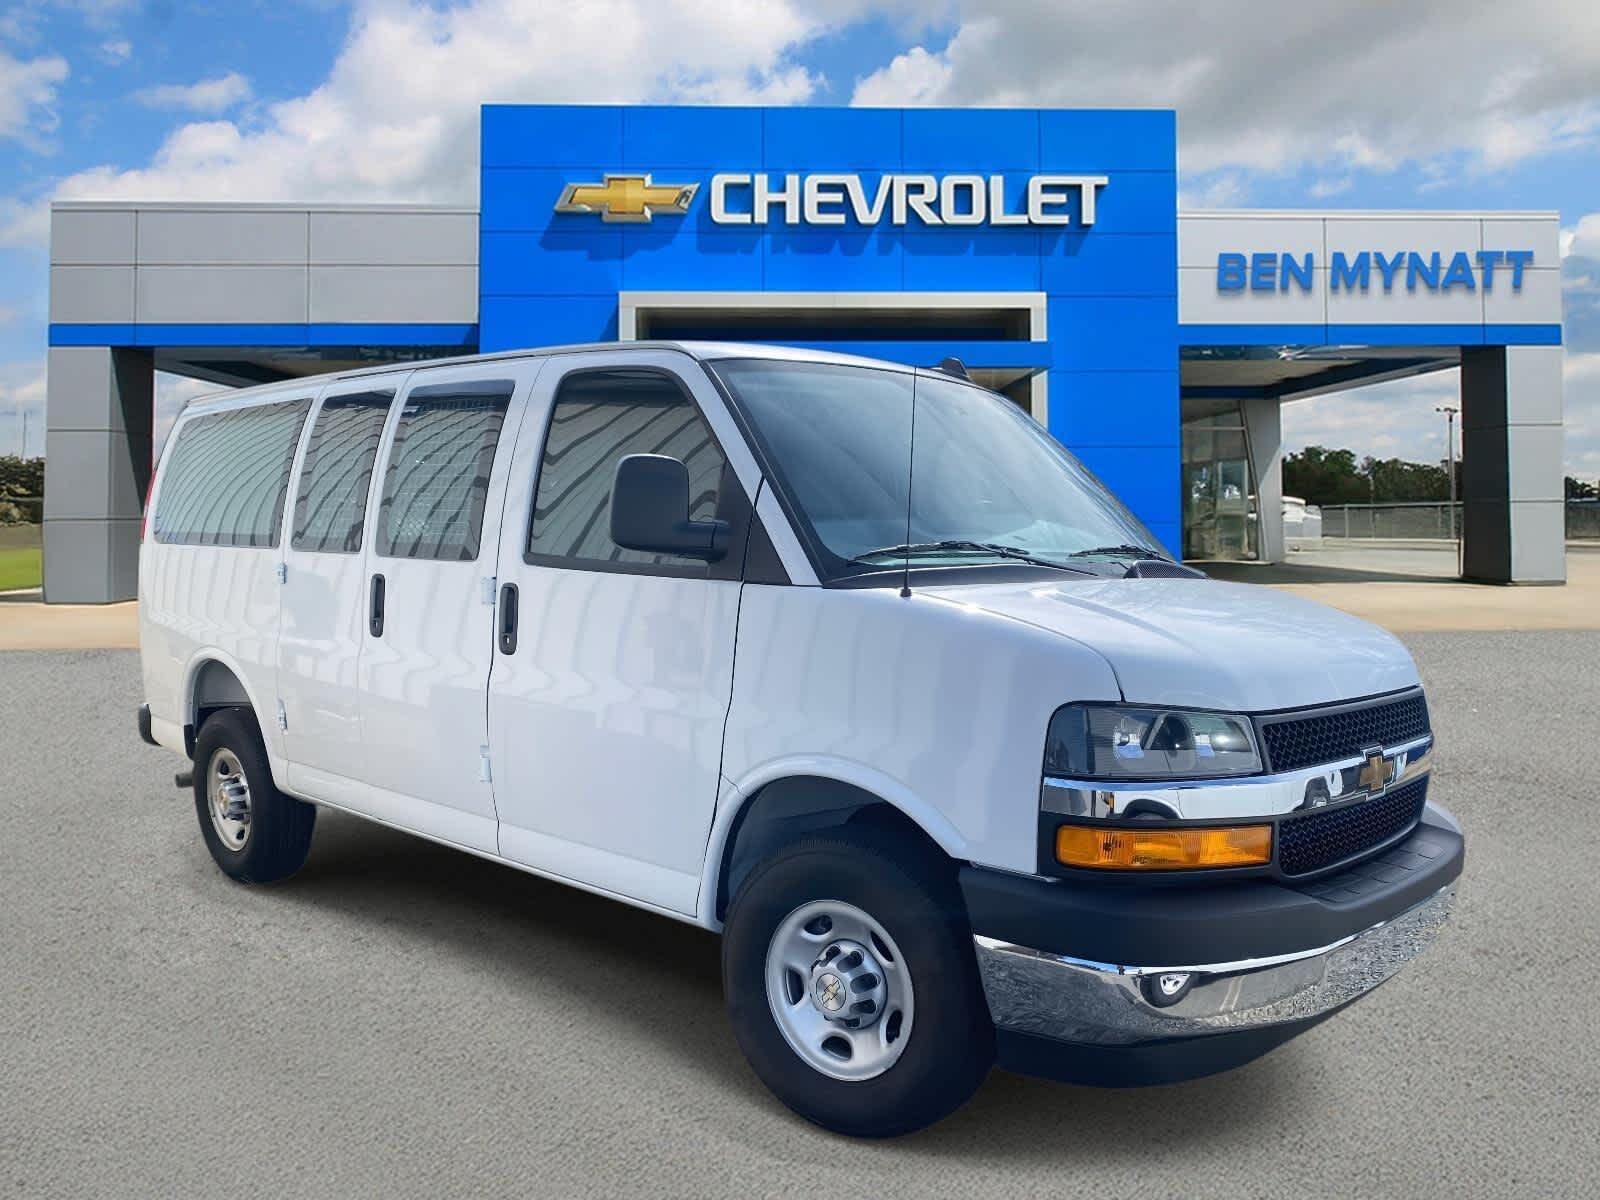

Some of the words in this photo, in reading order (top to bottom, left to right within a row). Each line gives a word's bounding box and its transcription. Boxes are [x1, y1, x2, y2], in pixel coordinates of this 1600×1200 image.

[710, 174, 1108, 226] CHEVROLET
[1217, 252, 1314, 291] BEN
[1330, 251, 1533, 291] MYNATT
